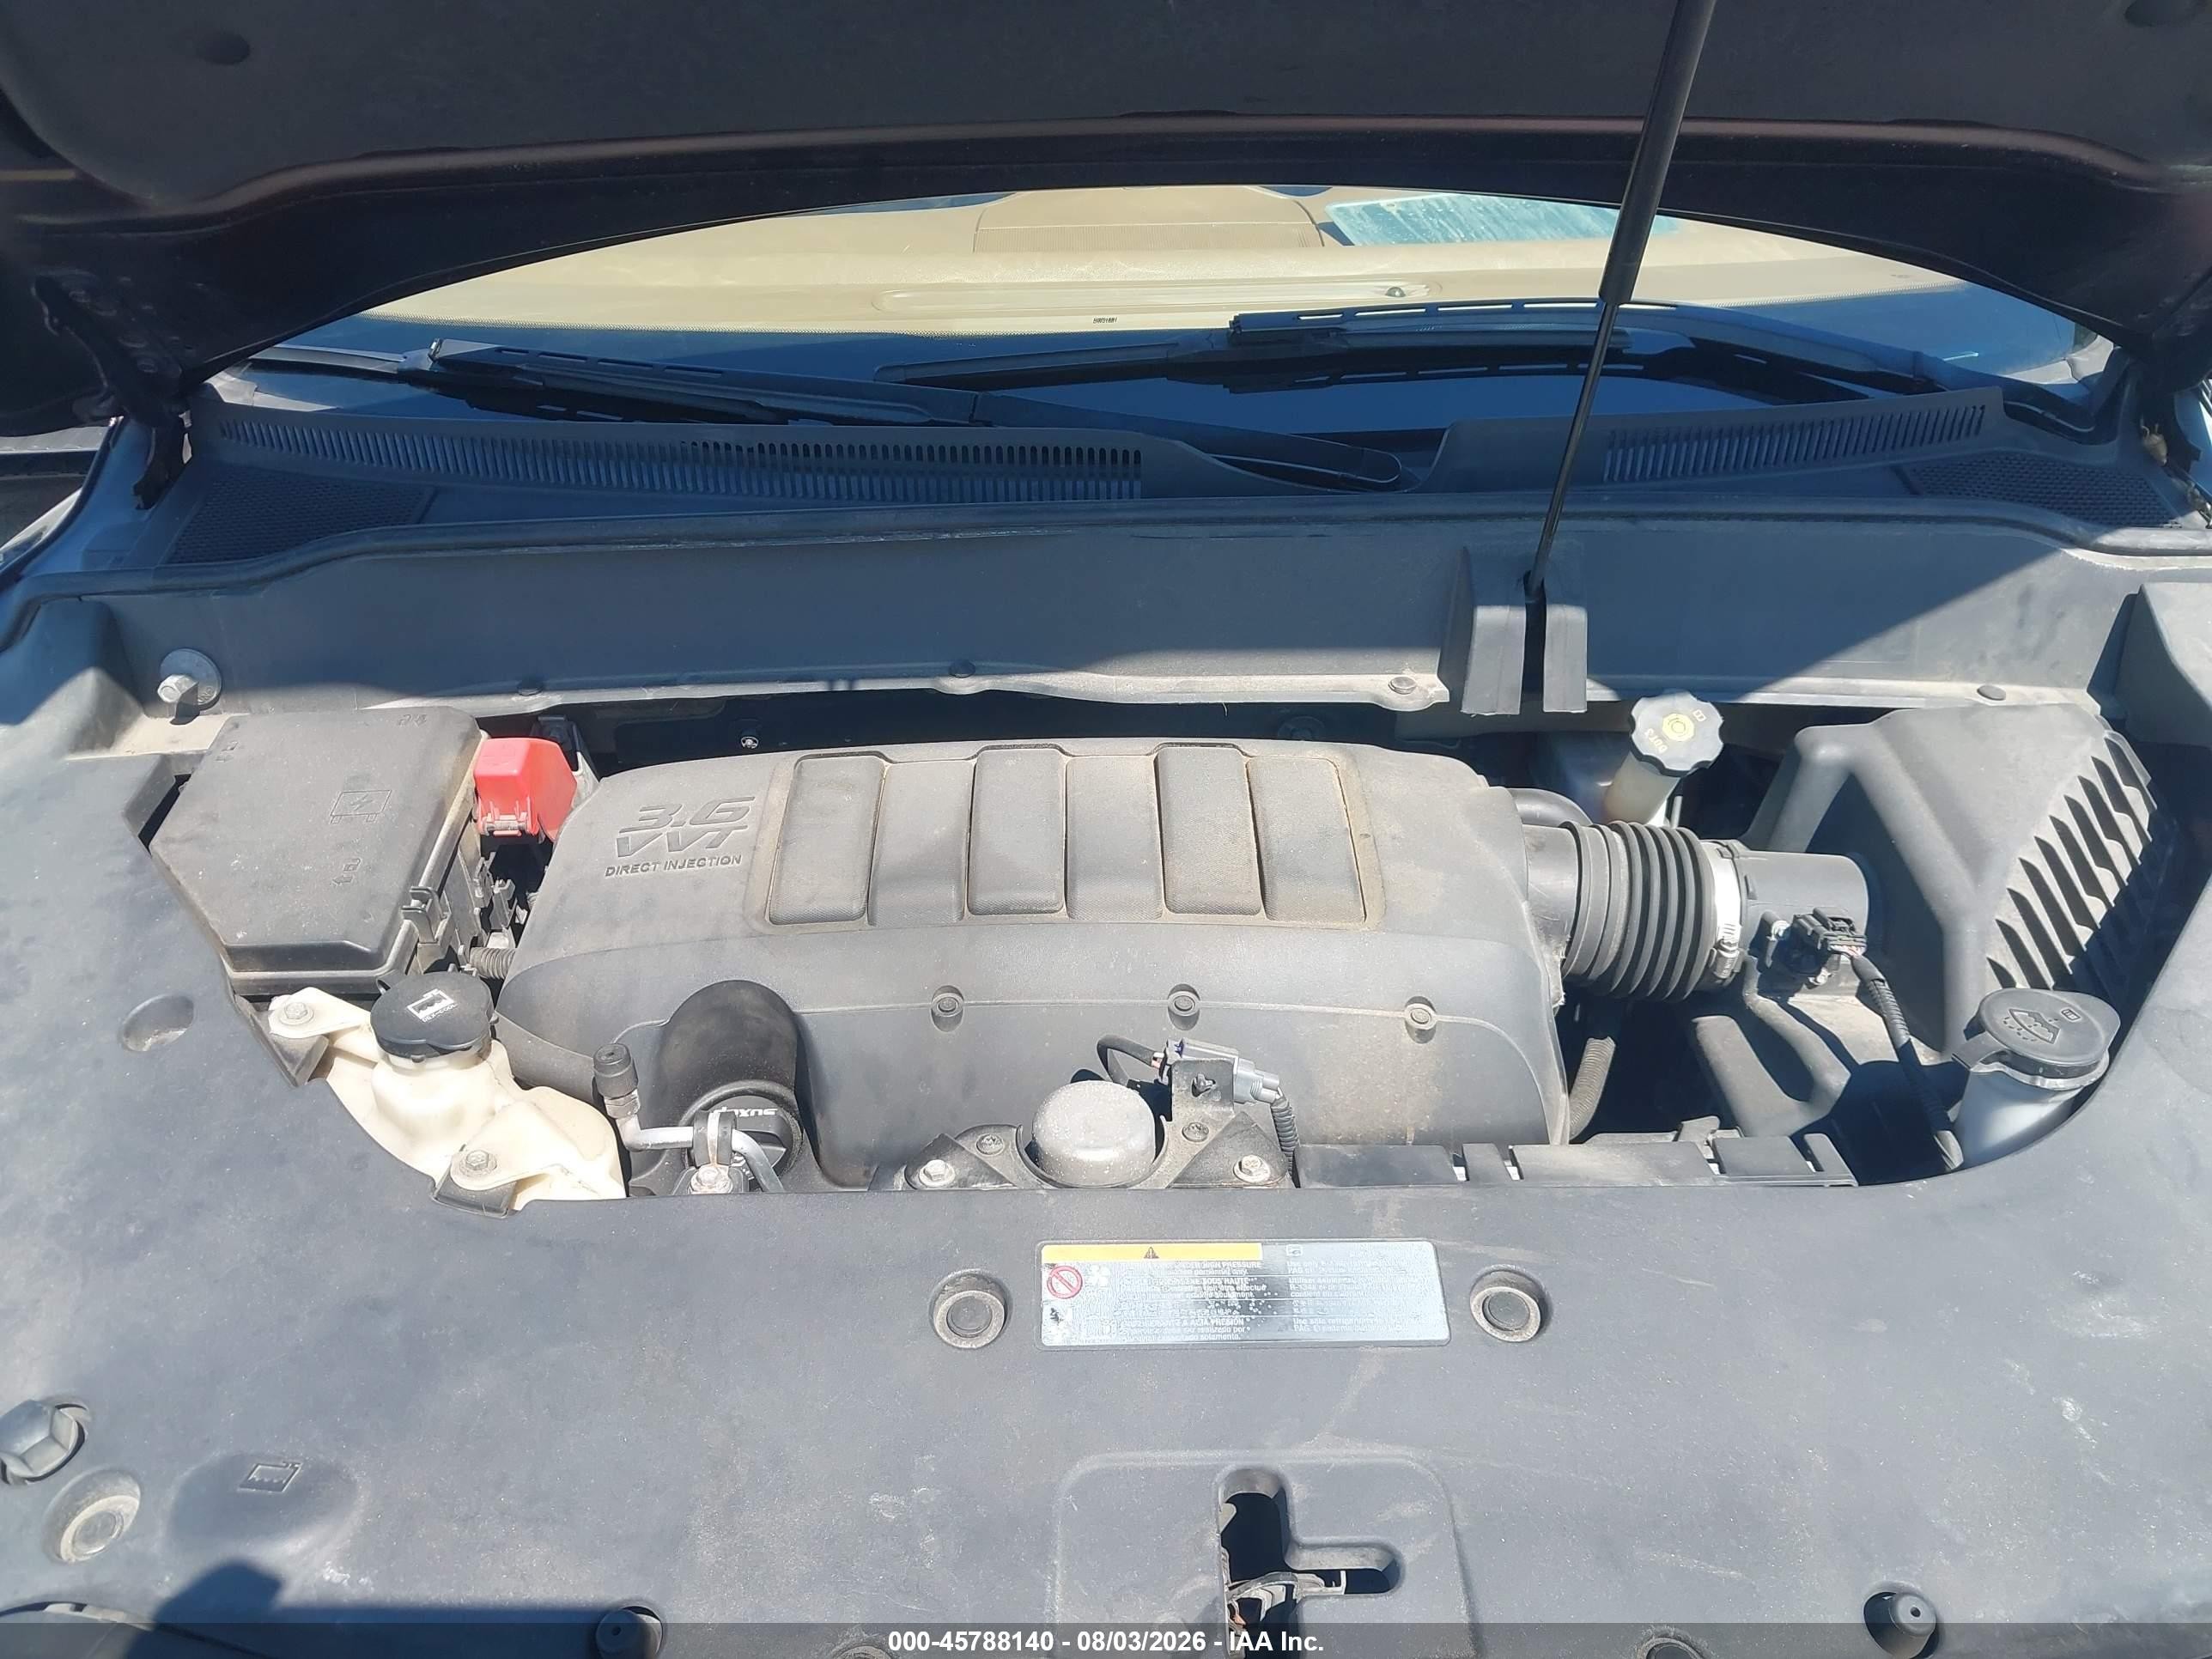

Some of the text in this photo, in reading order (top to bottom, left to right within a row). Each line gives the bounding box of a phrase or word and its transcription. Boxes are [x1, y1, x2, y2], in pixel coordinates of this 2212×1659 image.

[619, 796, 756, 834] 3.6
[616, 824, 749, 858] VVT
[605, 854, 742, 878] DIRECT INJECTION
